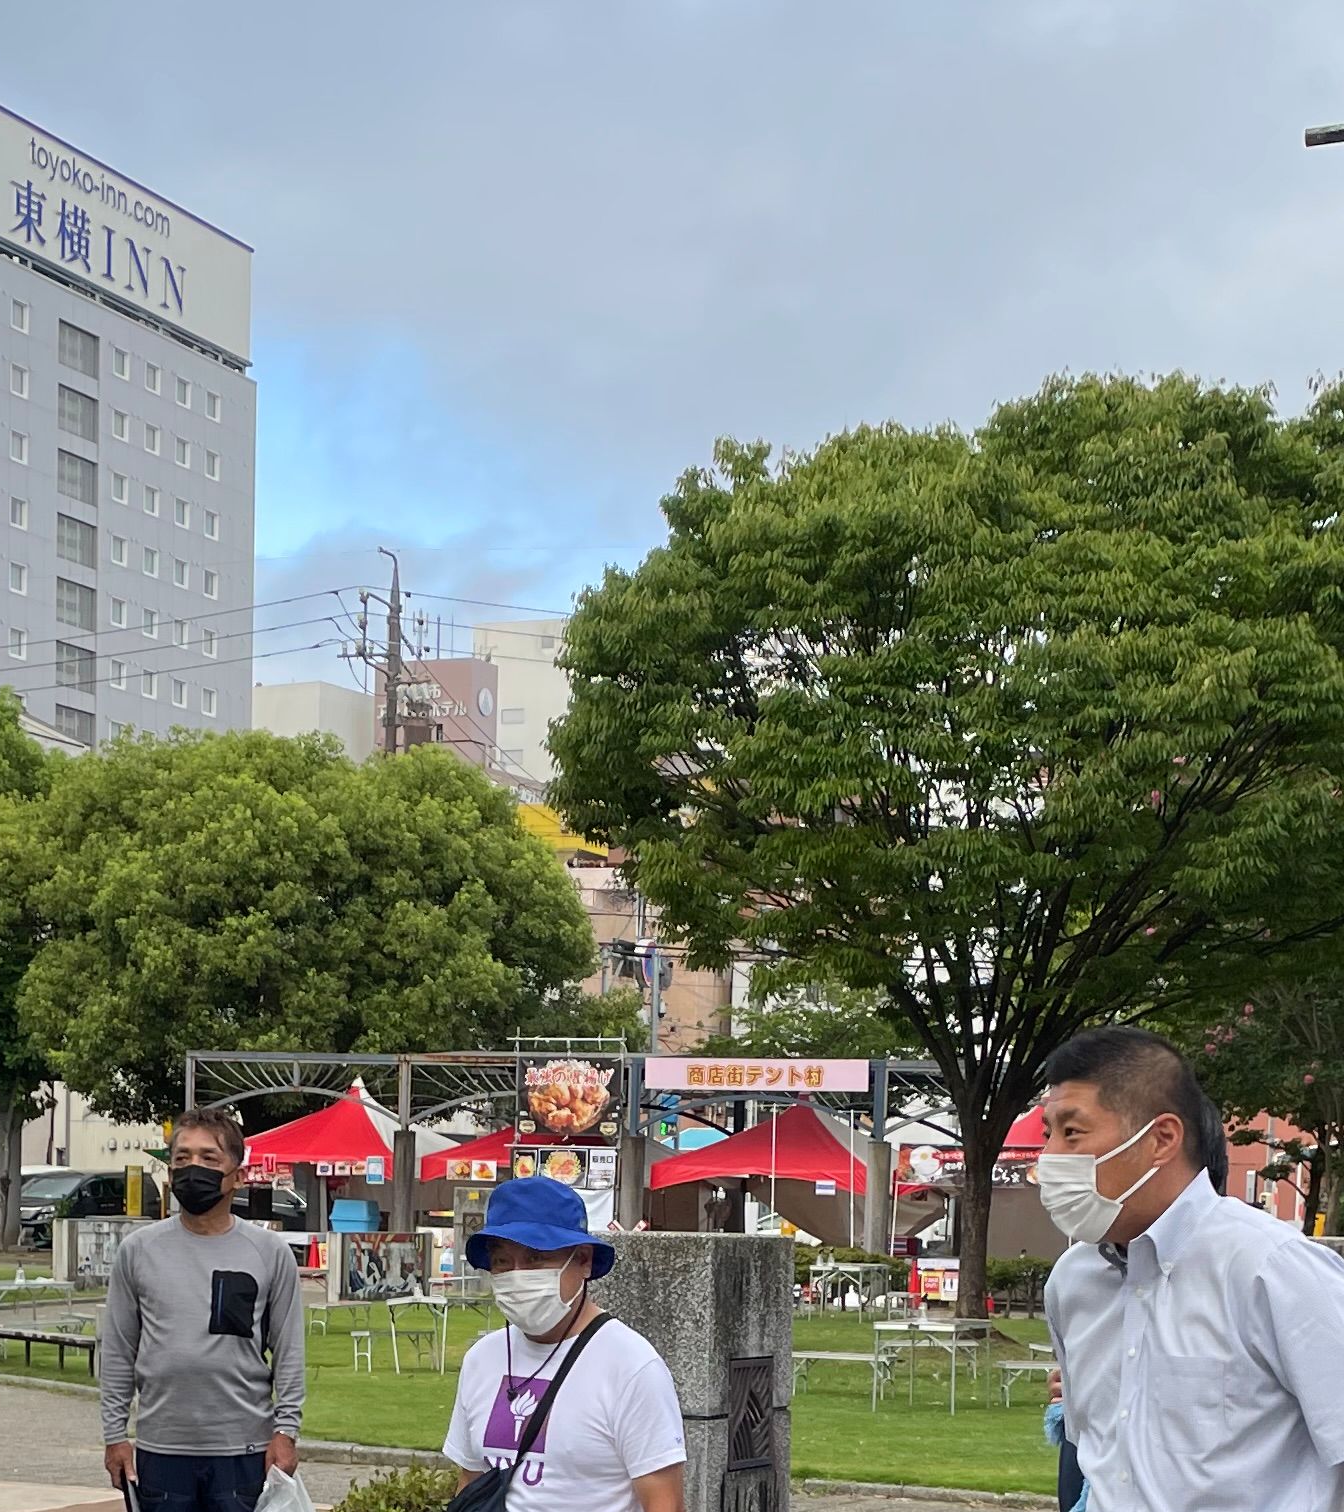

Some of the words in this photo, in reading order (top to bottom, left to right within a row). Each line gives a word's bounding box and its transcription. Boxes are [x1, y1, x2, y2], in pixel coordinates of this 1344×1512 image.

[28, 136, 171, 239] toyoko-inn.com
[9, 179, 187, 316] 東横INN
[686, 1064, 825, 1088] 商店街テント村
